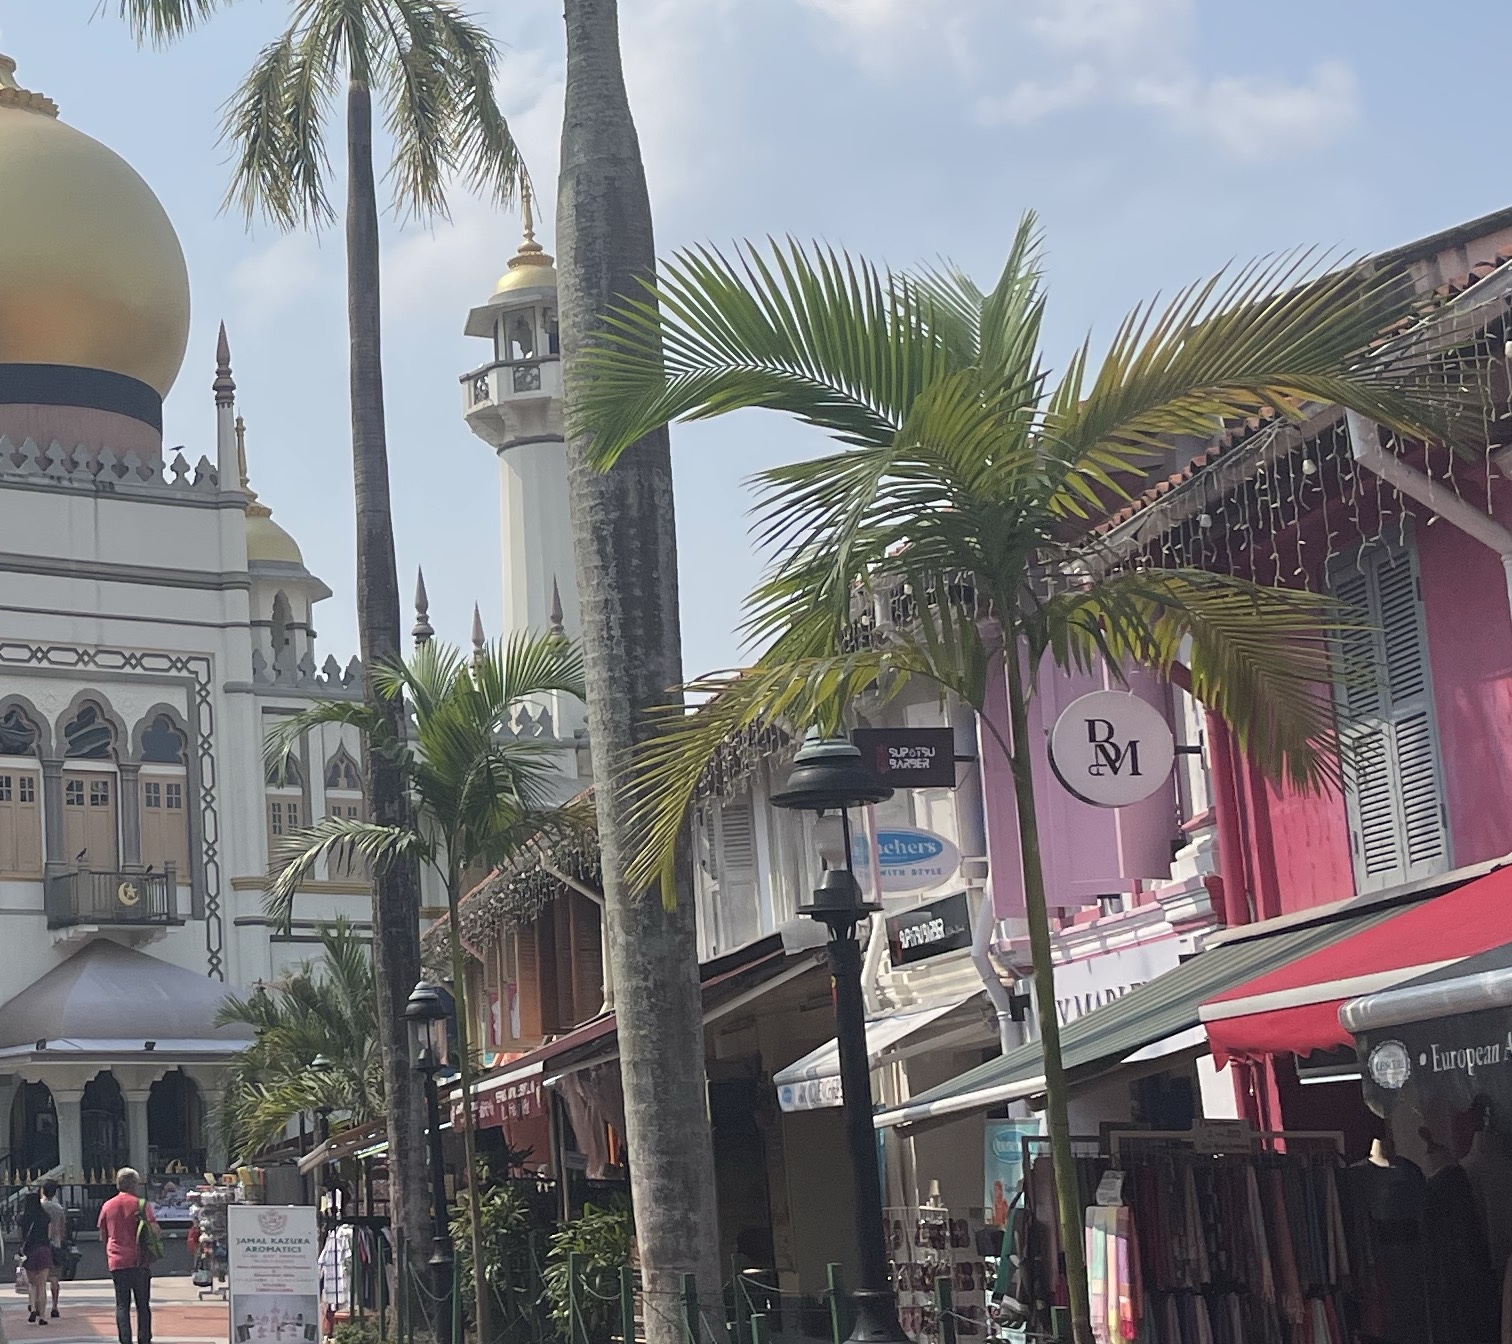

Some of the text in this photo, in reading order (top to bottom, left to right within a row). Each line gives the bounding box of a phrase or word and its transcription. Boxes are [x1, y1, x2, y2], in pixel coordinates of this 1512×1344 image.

[889, 758, 930, 769] BARBER
[1430, 1042, 1501, 1077] European
[235, 1237, 268, 1245] JAMAL
[244, 1245, 303, 1253] AROMATICS
